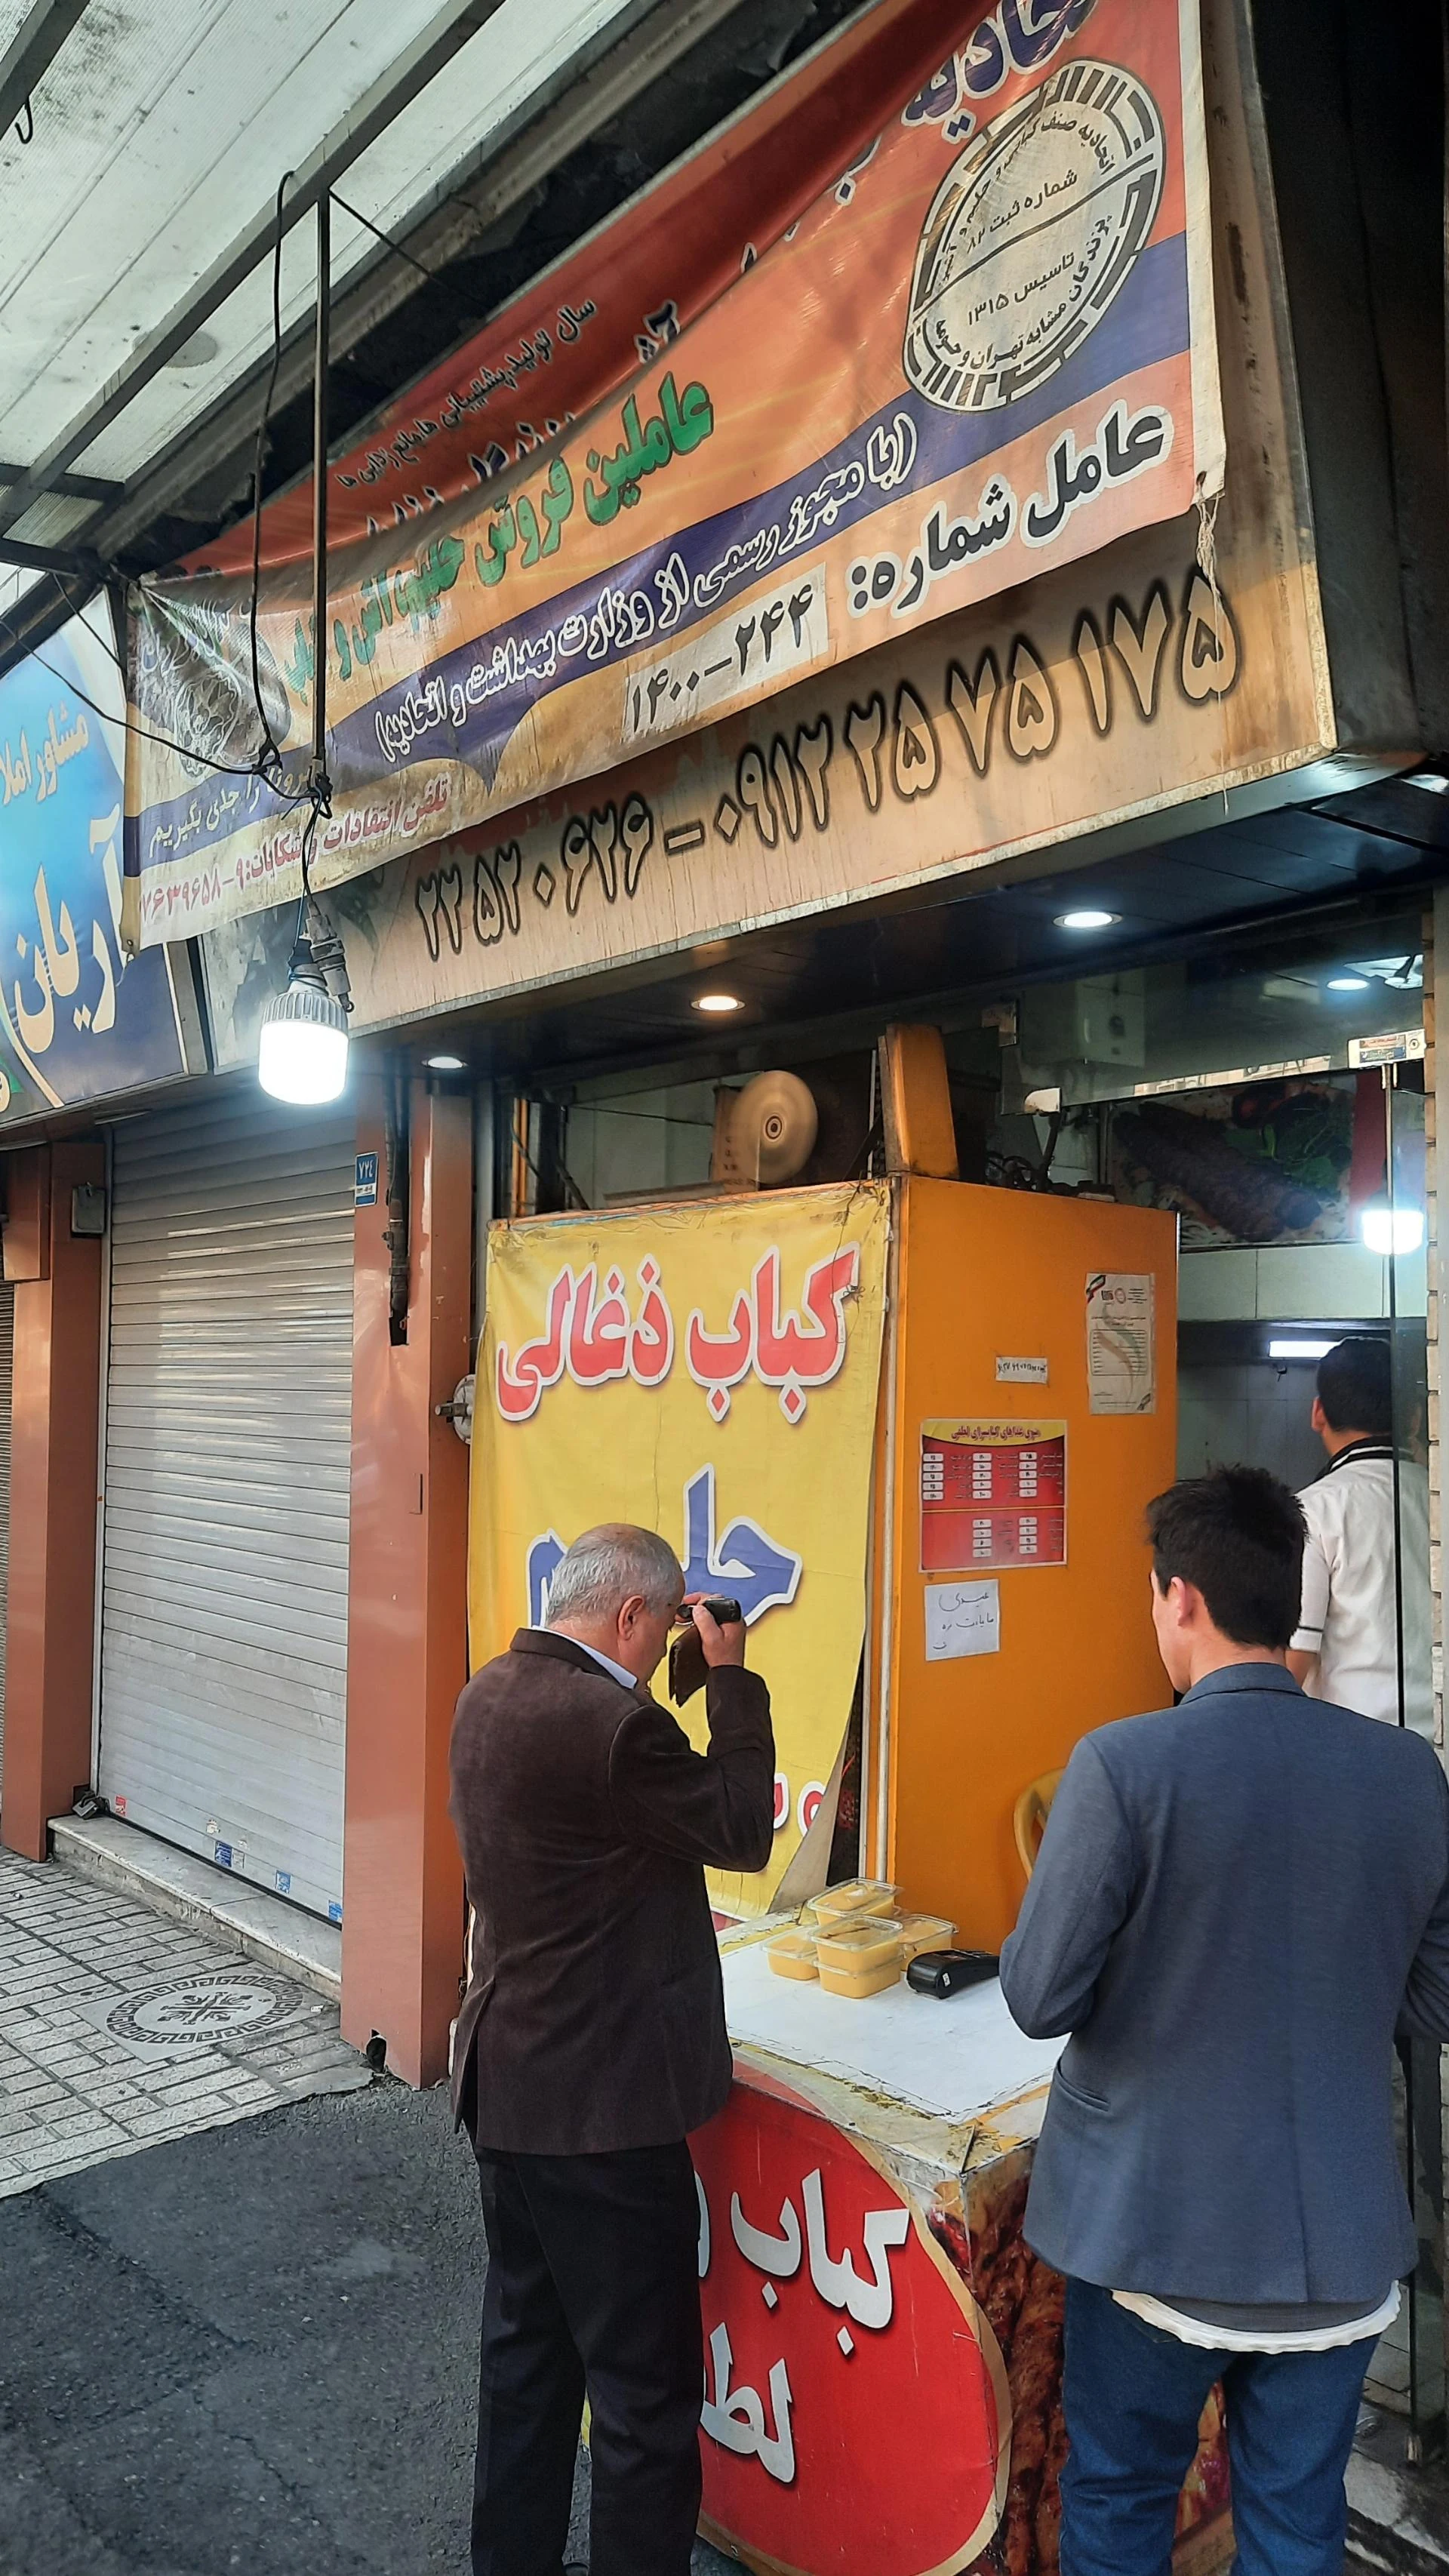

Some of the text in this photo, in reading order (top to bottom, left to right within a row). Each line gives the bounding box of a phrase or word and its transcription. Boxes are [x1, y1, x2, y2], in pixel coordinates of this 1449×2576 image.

[1041, 110, 1078, 133] صنف
[989, 199, 1020, 233] ثبت
[1023, 168, 1078, 210] شماره
[968, 251, 1075, 326] تاسیس ۱۳۱۵
[557, 299, 596, 343] سال
[1026, 302, 1067, 345] مشابه
[970, 336, 1023, 371] تهران
[334, 472, 358, 489] ها
[583, 372, 714, 526] عاملین
[1024, 405, 1170, 543] عامل
[474, 454, 574, 587] فروش
[778, 460, 864, 557] مجوز
[654, 552, 686, 629] از
[694, 525, 779, 607] رسمی
[334, 619, 352, 682] و
[558, 586, 656, 662] وزارت
[466, 629, 556, 705] بهداشت
[451, 683, 466, 726] و
[36, 700, 88, 803] مشاور
[207, 788, 240, 831] جدی
[246, 774, 260, 814] را
[324, 799, 401, 848] انتقادات
[404, 778, 449, 830] تلفن
[497, 1244, 860, 1423] کباب ذغالی
[731, 2167, 910, 2357] کباب
